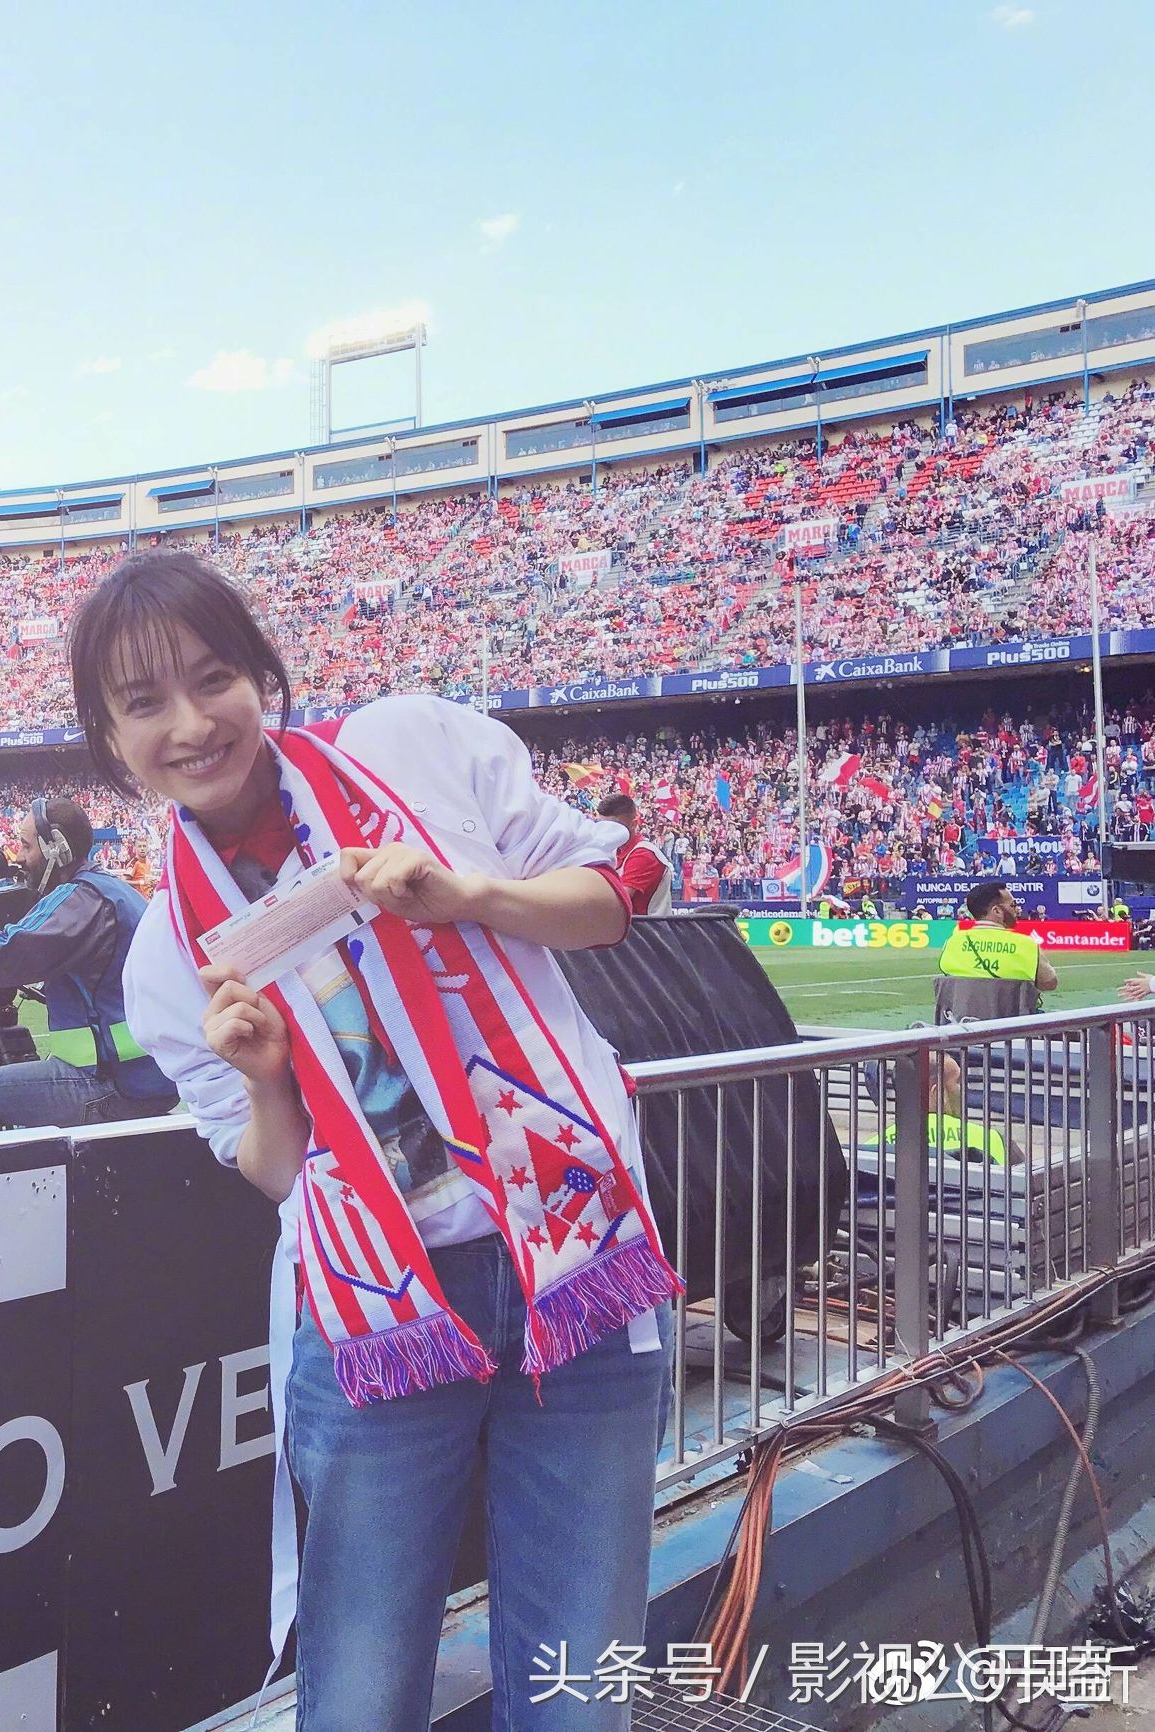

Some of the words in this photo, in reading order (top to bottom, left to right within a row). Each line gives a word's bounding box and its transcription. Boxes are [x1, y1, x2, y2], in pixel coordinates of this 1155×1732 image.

[1064, 478, 1130, 500] MARCA
[561, 555, 607, 573] MARCA
[987, 646, 1070, 666] Plus500
[838, 656, 924, 677] CaixaBank
[569, 683, 640, 701] CaixaBank
[692, 675, 759, 691] Plus500
[0, 736, 44, 747] Plus500
[917, 883, 952, 892] NUNCA
[1006, 882, 1044, 892] SENTIR
[812, 920, 930, 949] bet365
[1047, 931, 1126, 949] Santander
[961, 940, 1017, 955] SEGURIDAD
[974, 957, 1000, 972] 204
